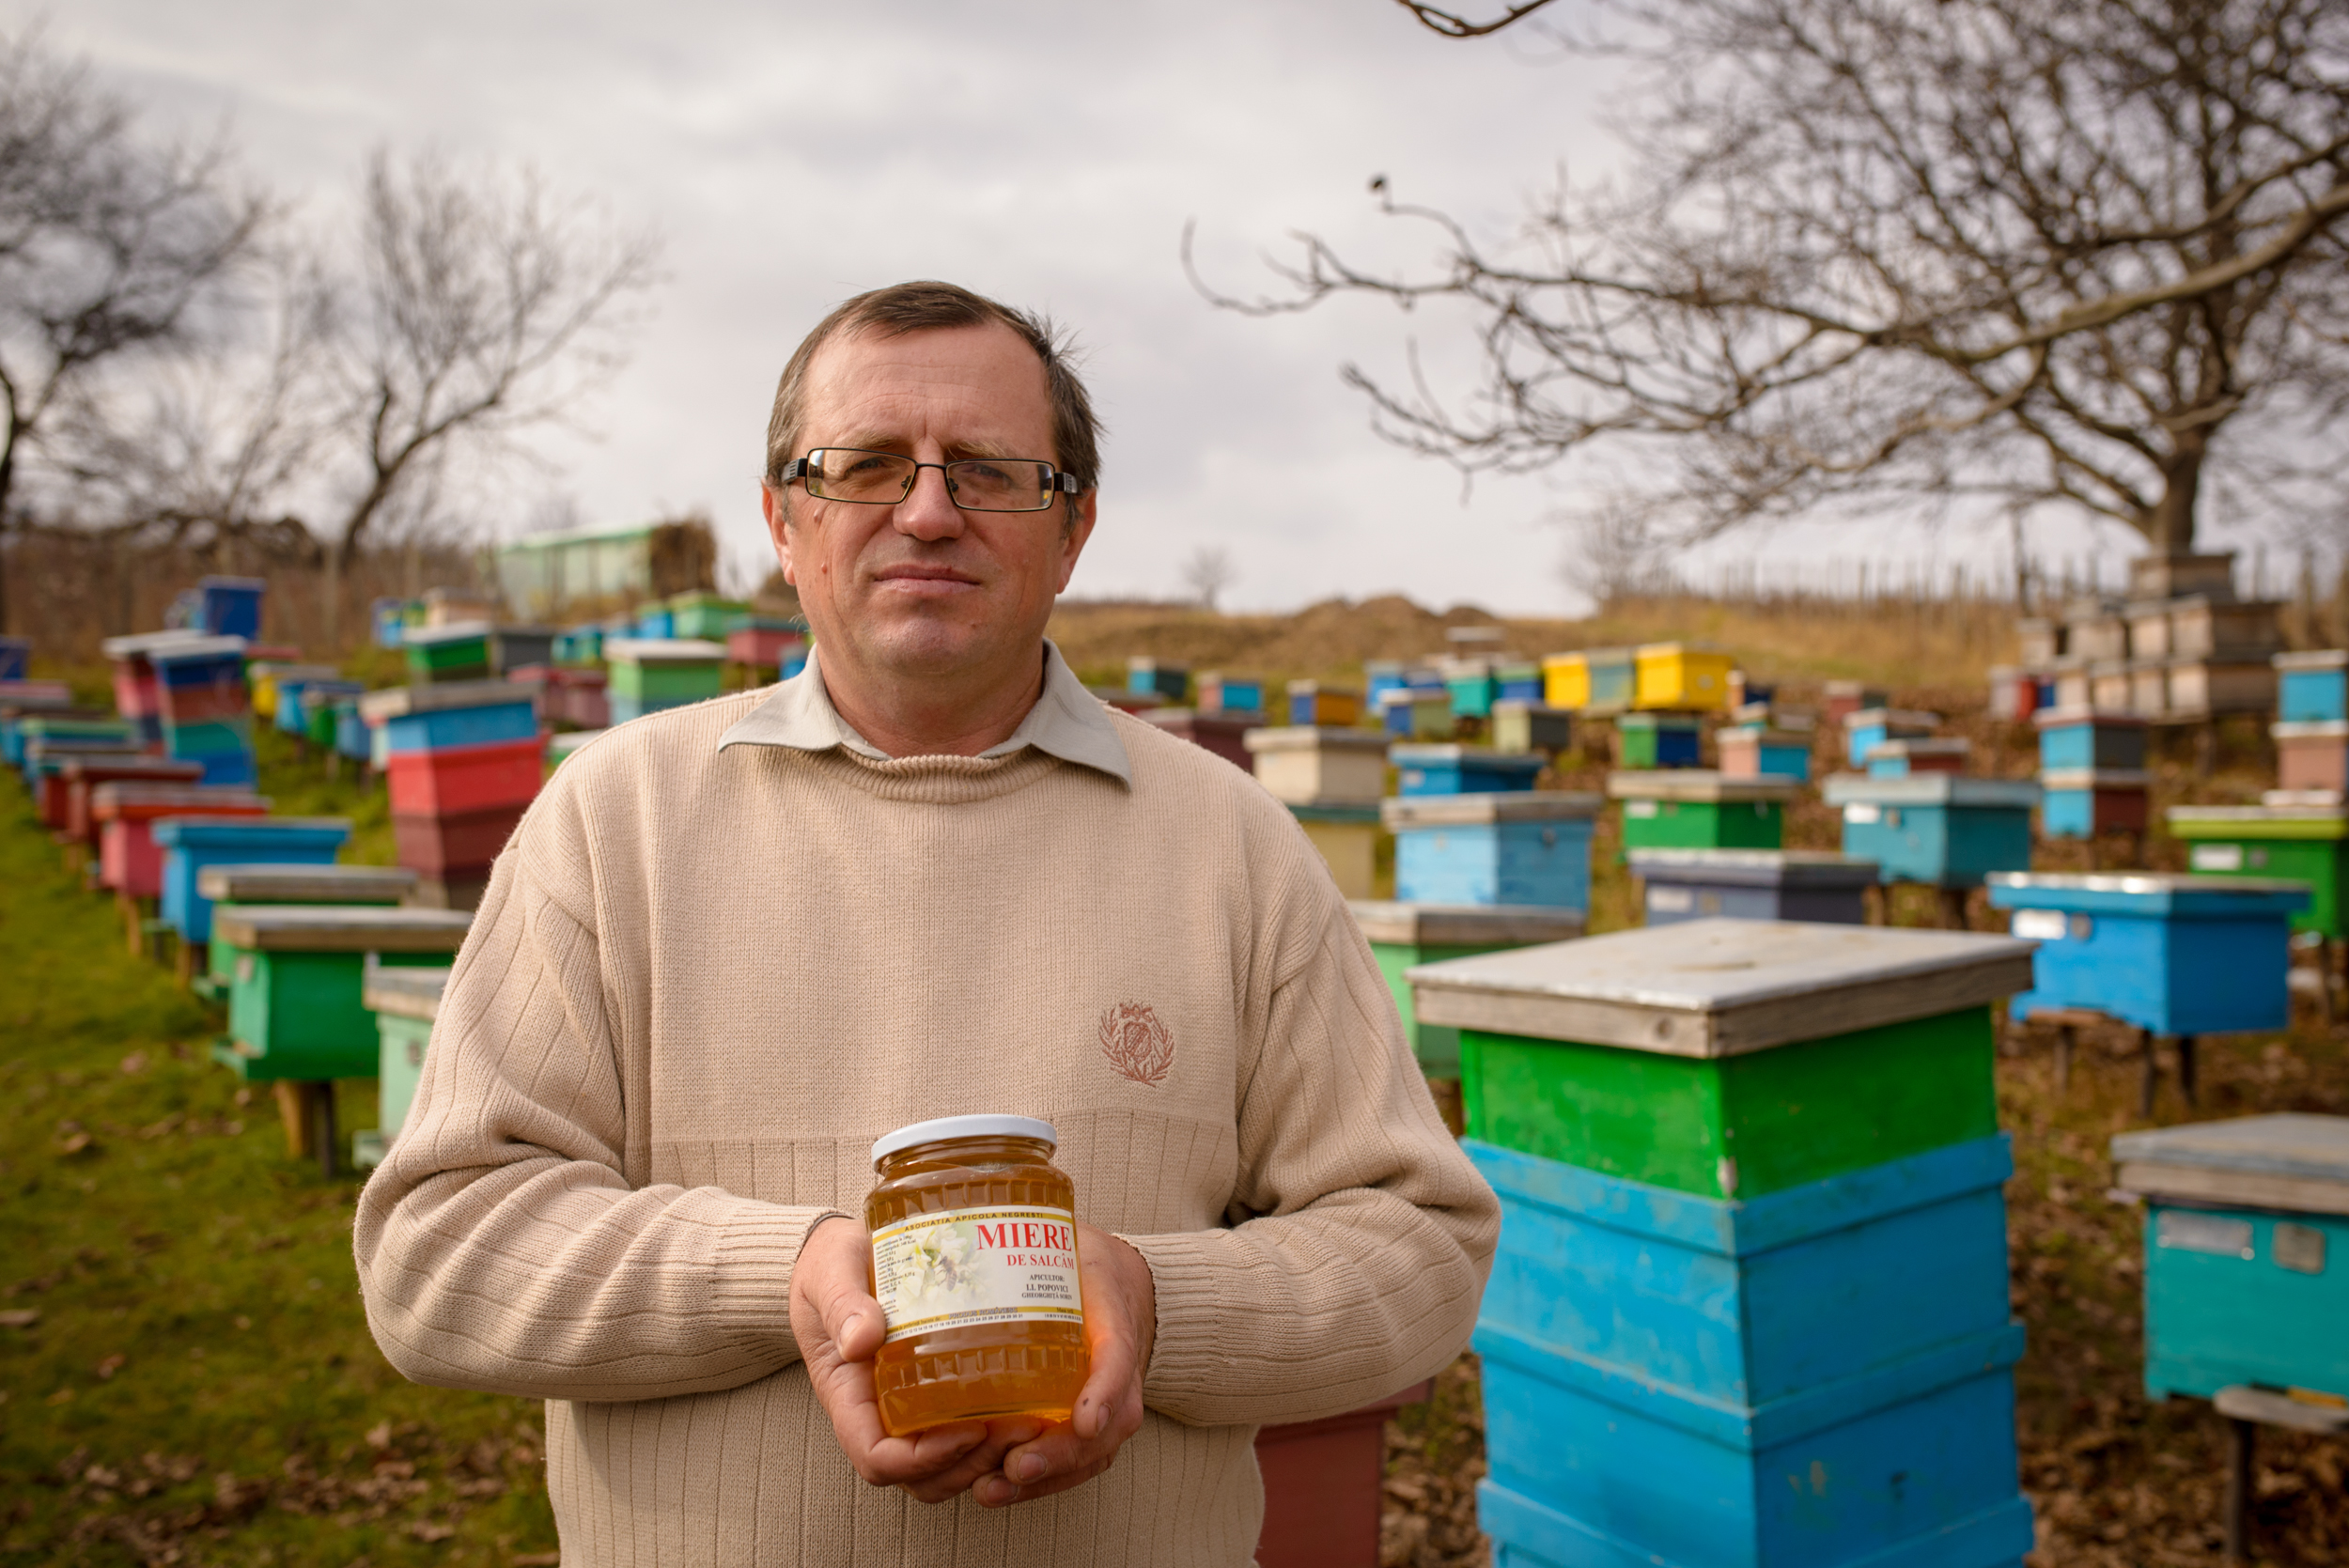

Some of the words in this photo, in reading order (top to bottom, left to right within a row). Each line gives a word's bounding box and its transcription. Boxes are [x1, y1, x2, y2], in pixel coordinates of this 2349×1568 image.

[905, 1218, 950, 1232] ASOCIATIA
[955, 1212, 998, 1222] APICOLA
[974, 1222, 1071, 1251] MIERE
[1006, 1254, 1026, 1266] DE
[1030, 1252, 1074, 1270] SALCÂM
[1037, 1283, 1069, 1293] POPOVICI
